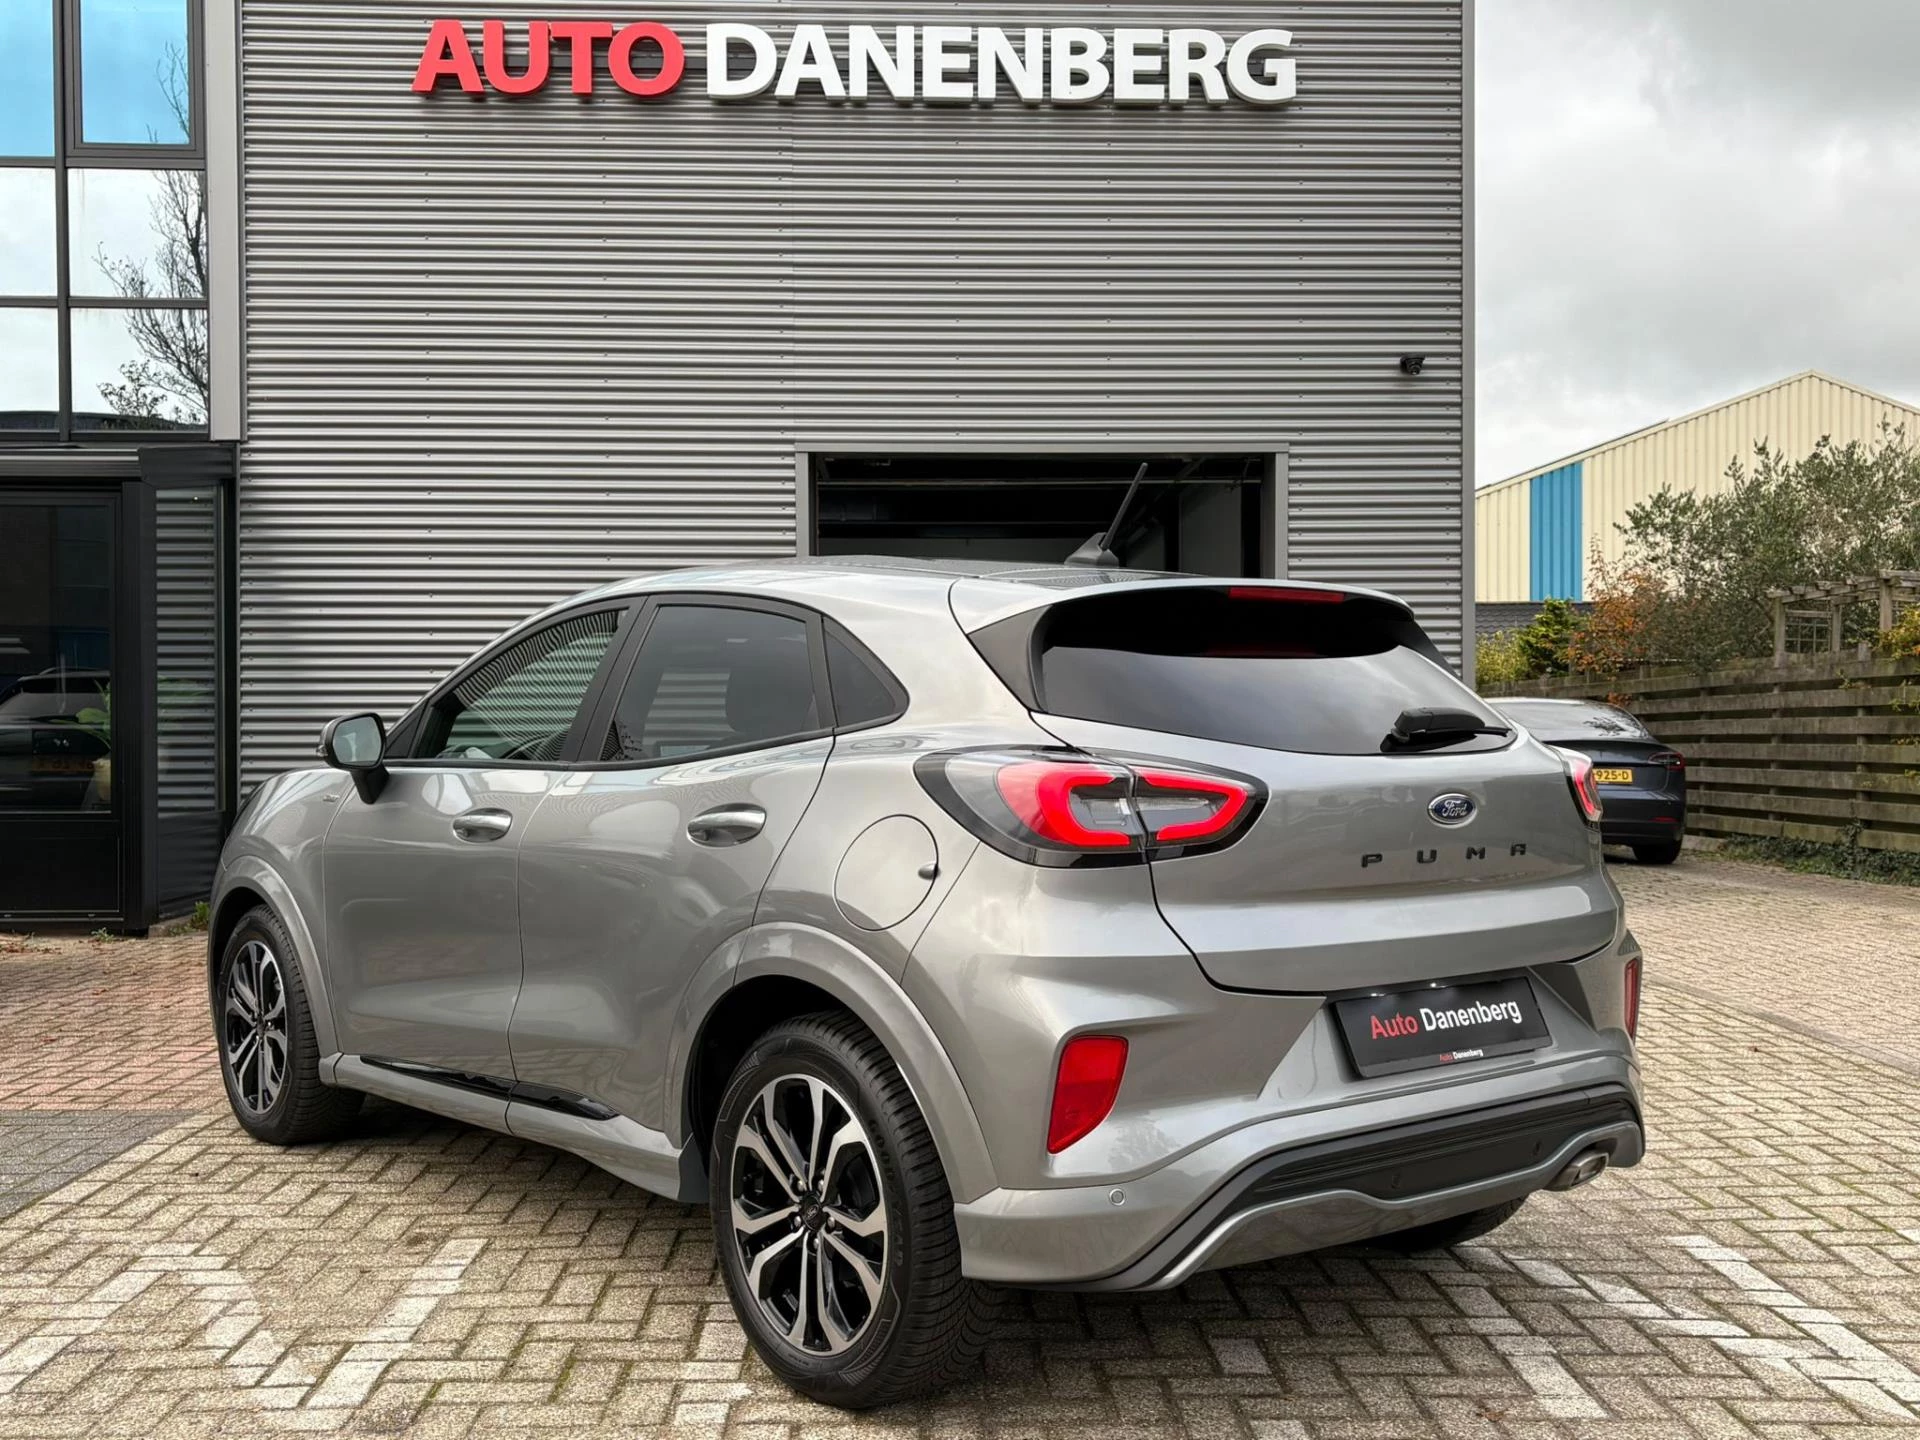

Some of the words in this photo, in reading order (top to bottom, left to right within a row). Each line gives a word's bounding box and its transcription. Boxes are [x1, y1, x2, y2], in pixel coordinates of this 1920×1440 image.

[411, 20, 685, 97] AUTO
[706, 22, 1298, 106] DANENBERG
[1442, 799, 1467, 817] Ford
[1361, 843, 1526, 868] PUMA
[1370, 1013, 1418, 1039] Auto
[1420, 1000, 1522, 1031] Danenberg
[1453, 1049, 1483, 1060] Danenberg
